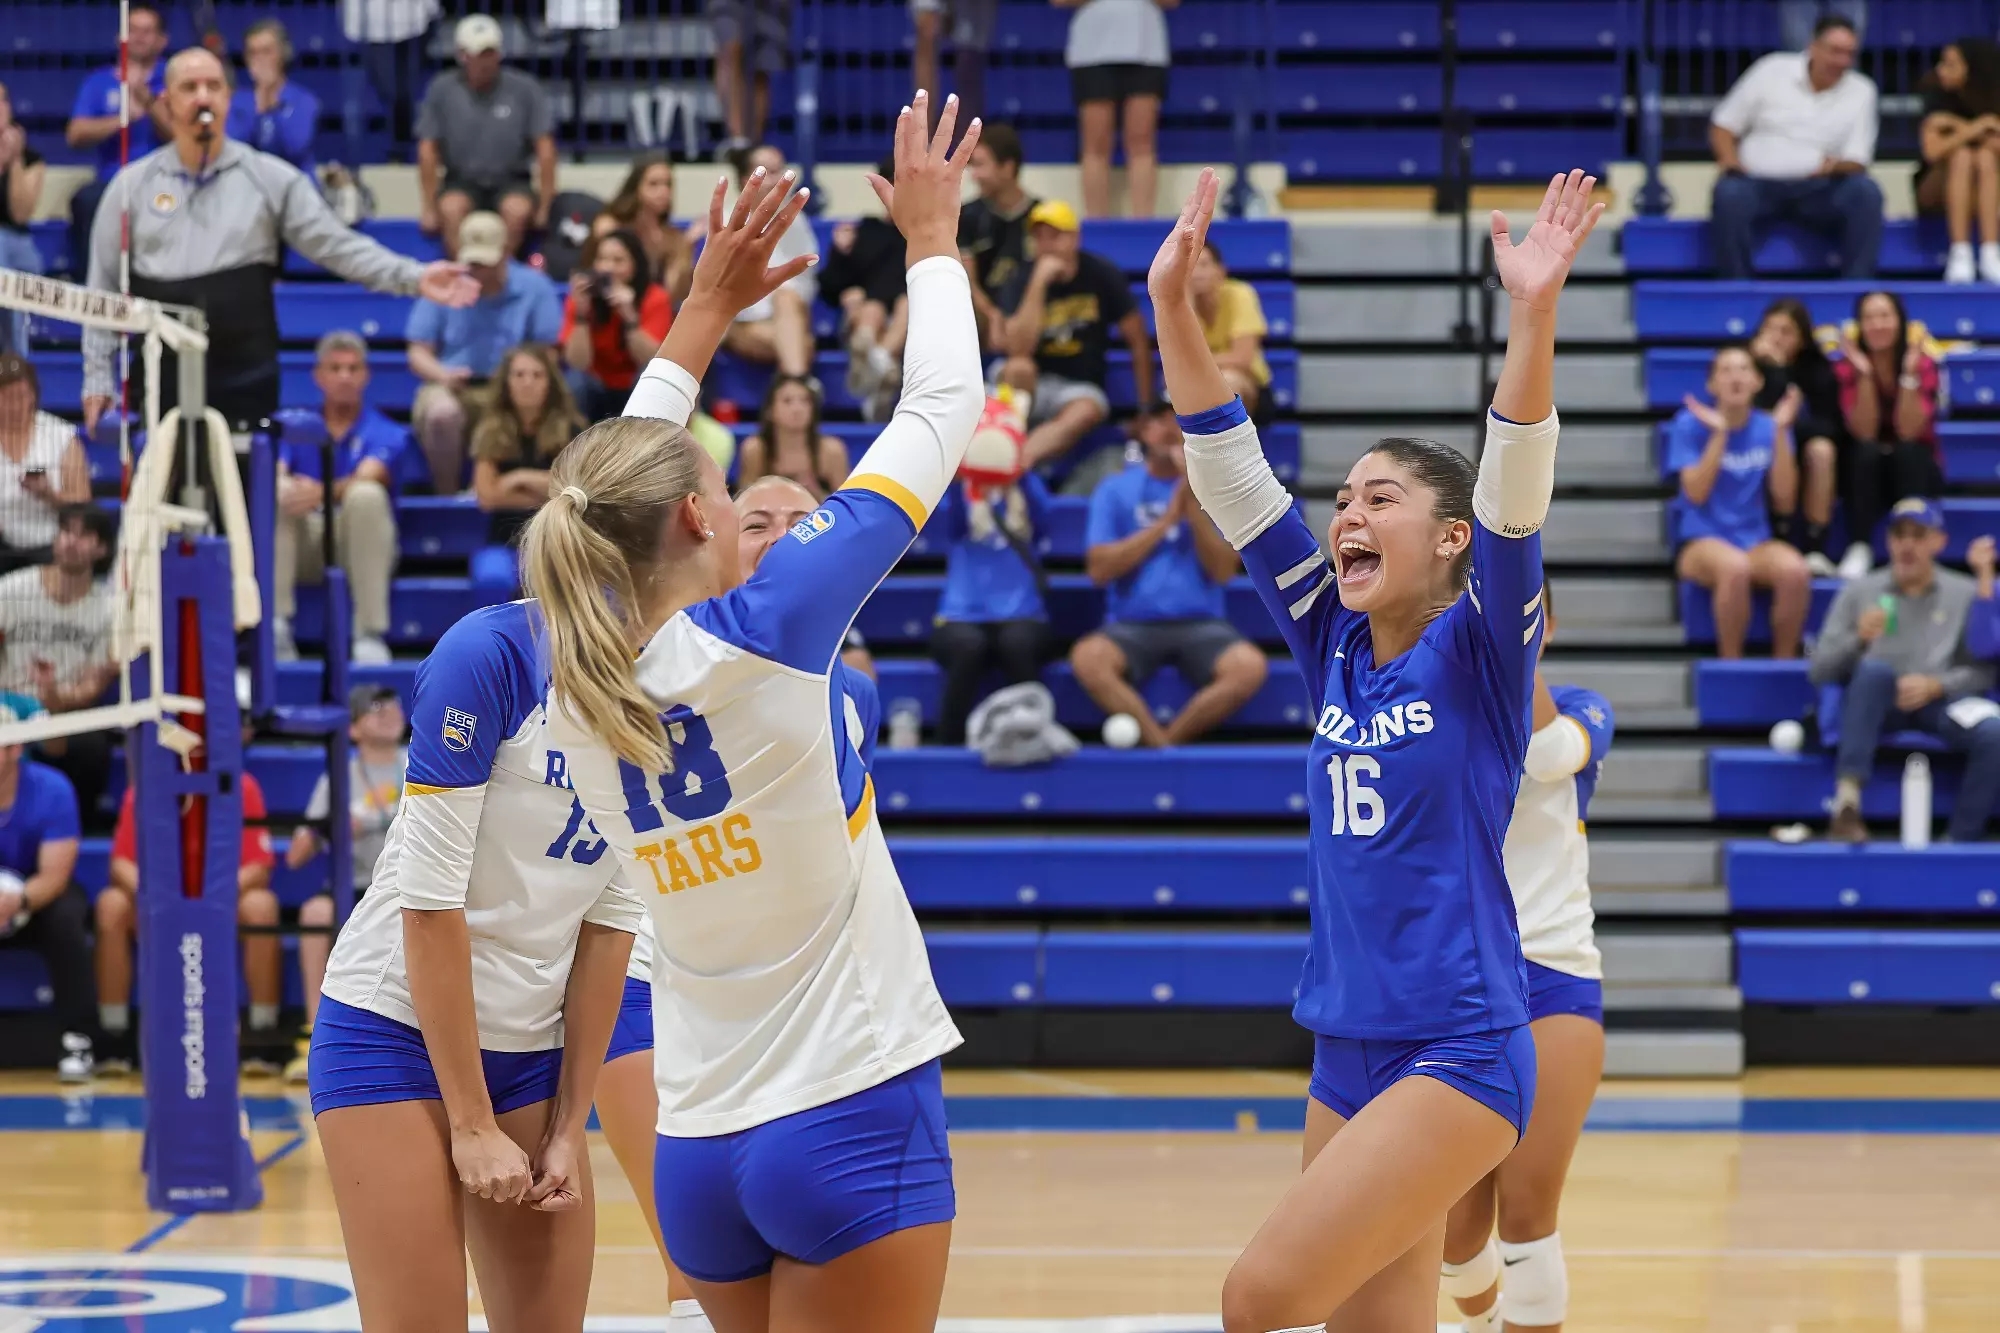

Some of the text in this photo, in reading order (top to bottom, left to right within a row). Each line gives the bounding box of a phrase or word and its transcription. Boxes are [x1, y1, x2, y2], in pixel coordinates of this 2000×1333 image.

[447, 711, 473, 728] SSC
[1316, 701, 1434, 746] OLLINS
[618, 704, 732, 834] 18
[1327, 754, 1386, 836] 16
[633, 813, 762, 894] TARS
